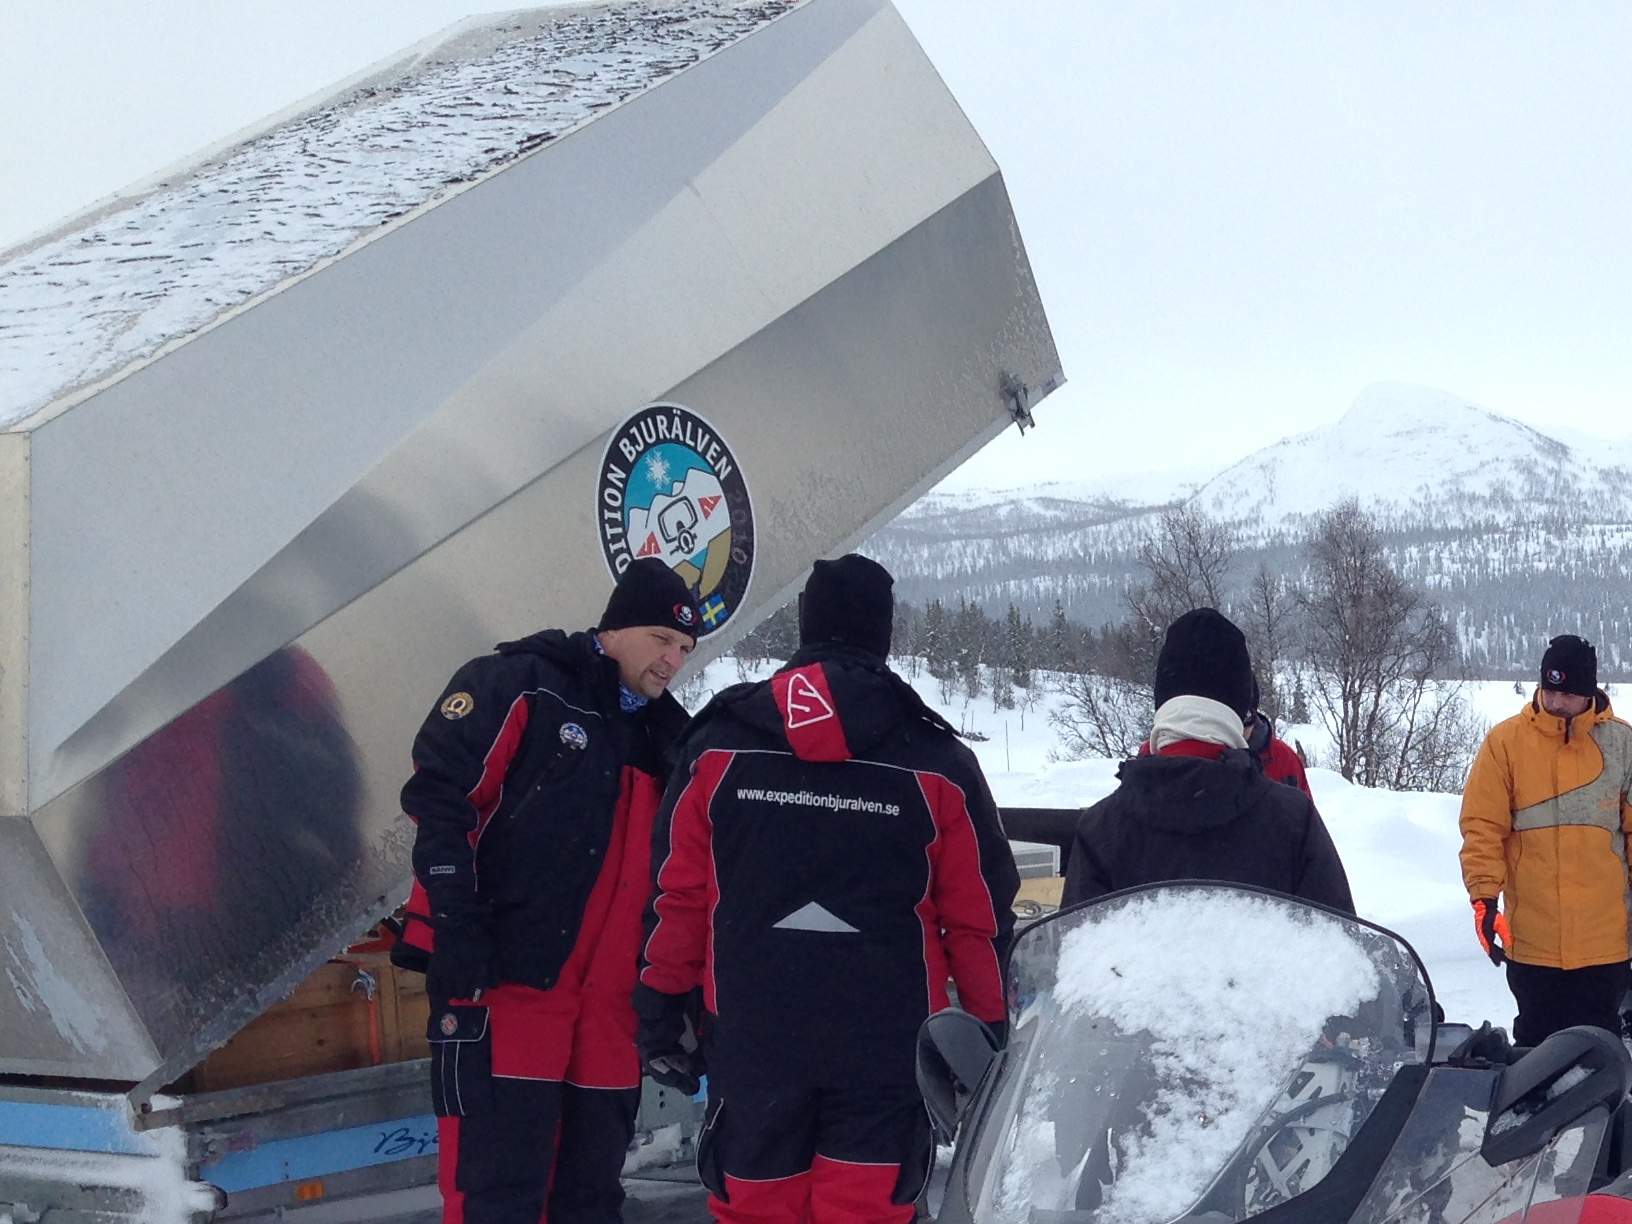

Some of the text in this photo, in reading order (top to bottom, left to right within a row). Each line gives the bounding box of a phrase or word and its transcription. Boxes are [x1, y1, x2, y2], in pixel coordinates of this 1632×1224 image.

[603, 408, 732, 574] DITION BJURÄLVEN
[736, 788, 900, 816] www.expeditionbjuralven.se
